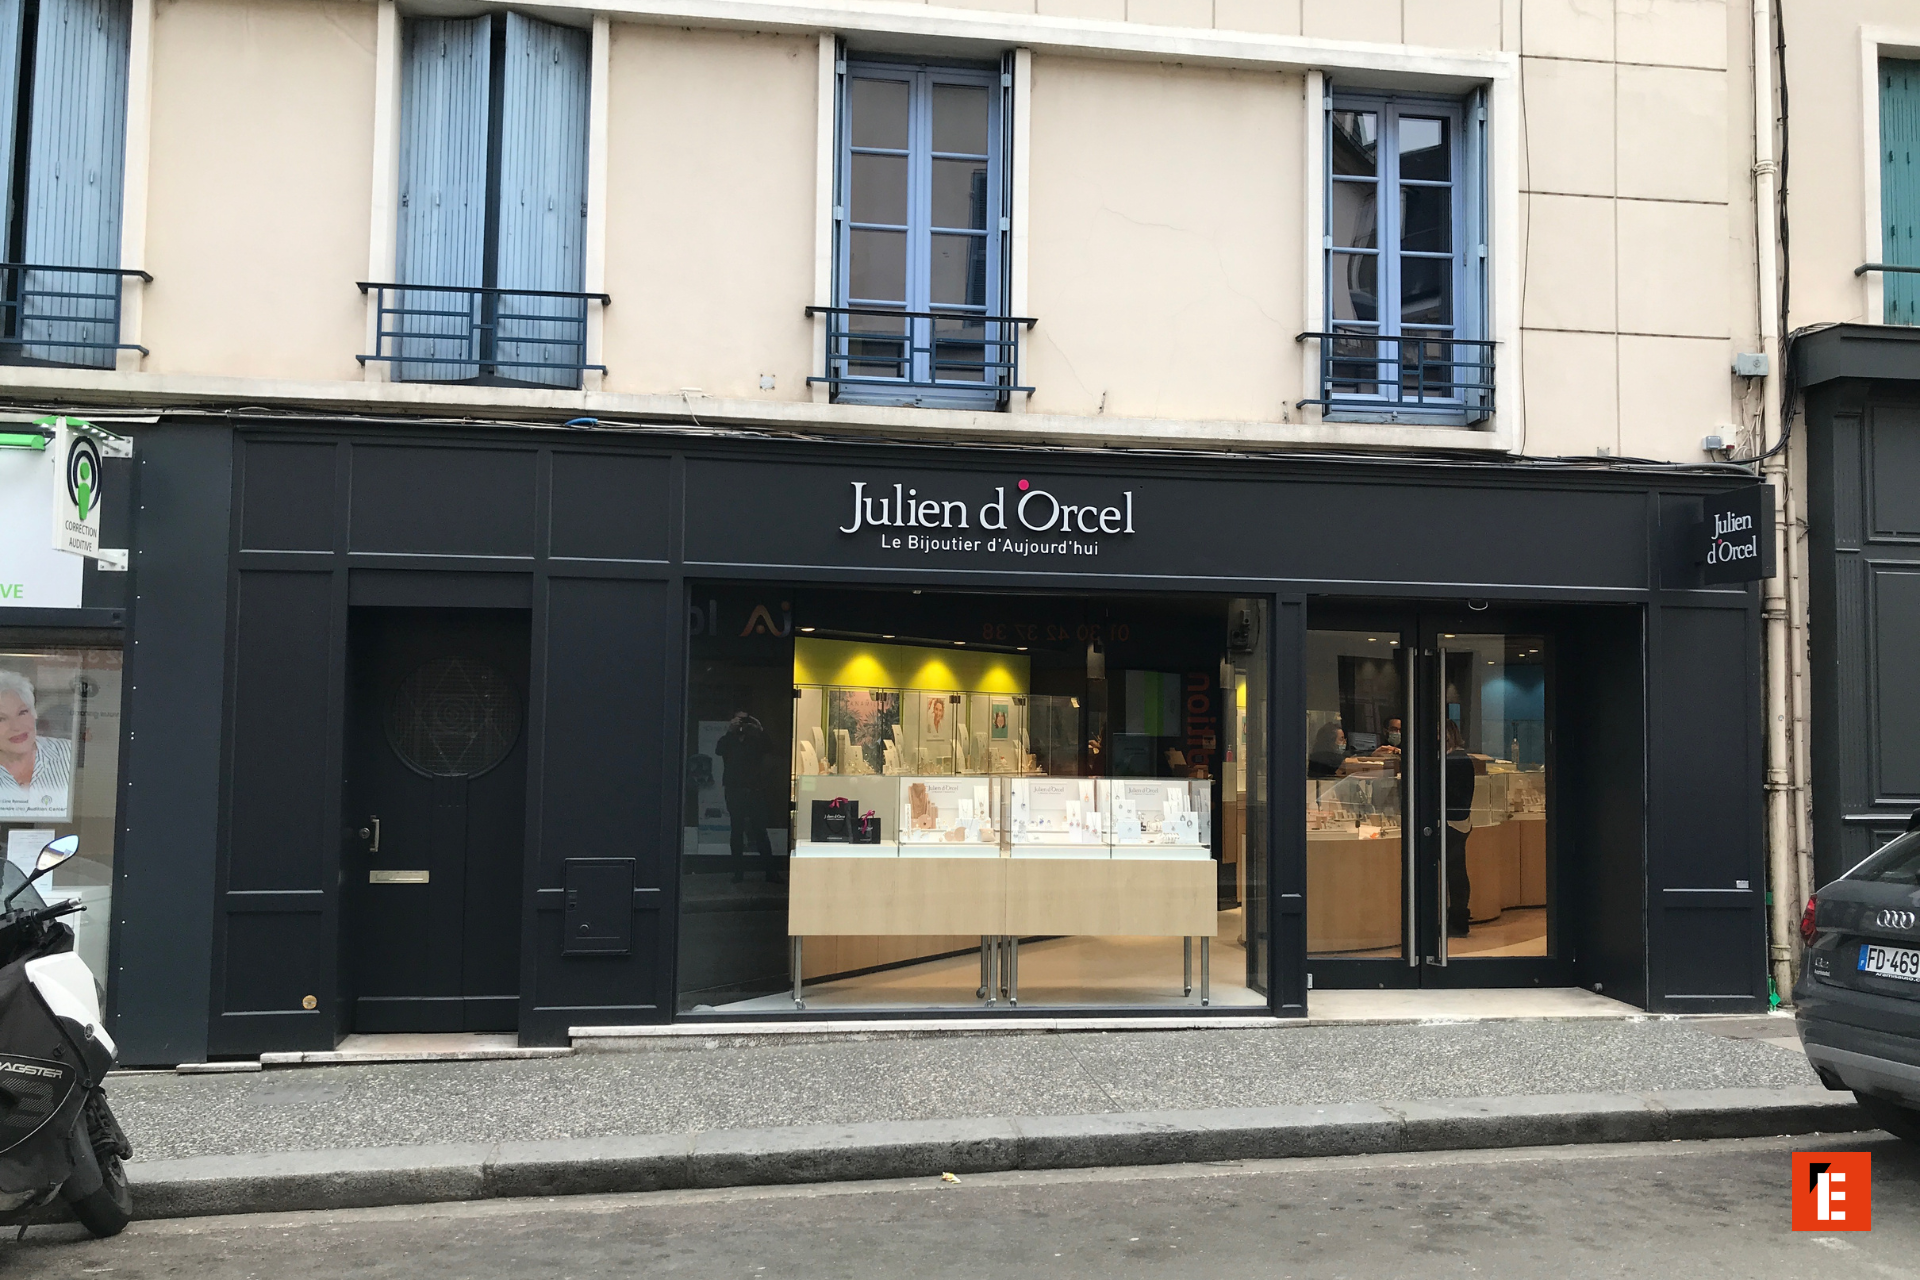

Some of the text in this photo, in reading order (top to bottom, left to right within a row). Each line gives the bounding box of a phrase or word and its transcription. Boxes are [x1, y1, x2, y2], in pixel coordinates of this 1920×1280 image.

[839, 481, 969, 533] Julien
[65, 520, 97, 538] CORRECTION
[1711, 511, 1752, 540] Julien
[69, 537, 92, 552] AUDITIVE
[881, 534, 1098, 556] Le Bijoutier d'Aujourd'hui
[0, 1061, 63, 1079] AGSTER
